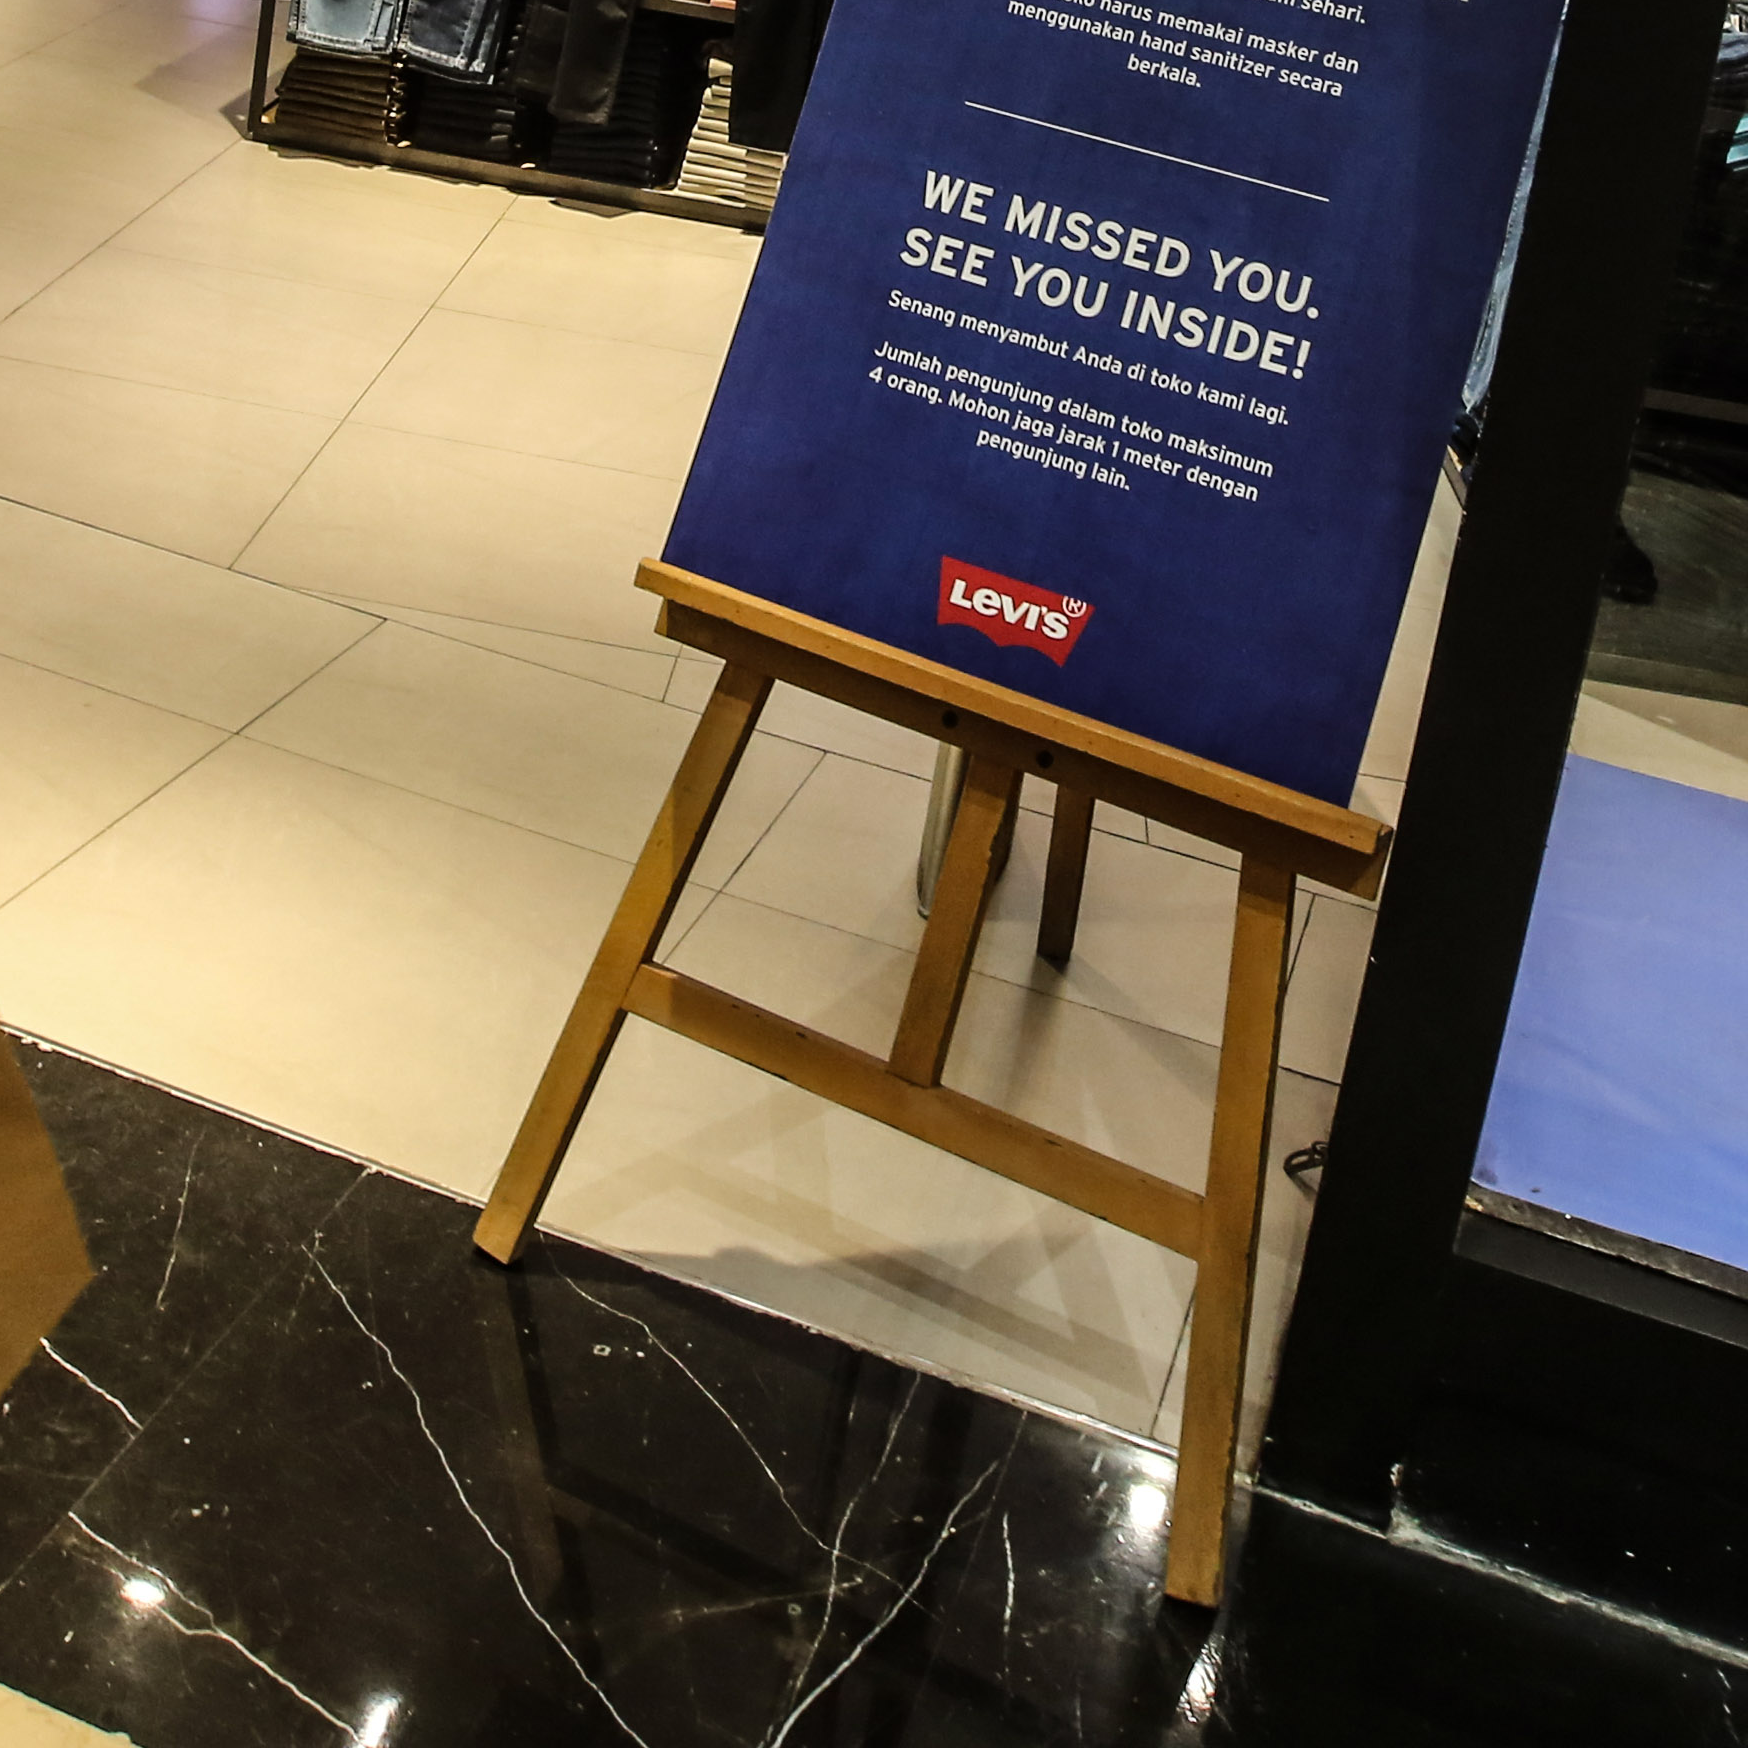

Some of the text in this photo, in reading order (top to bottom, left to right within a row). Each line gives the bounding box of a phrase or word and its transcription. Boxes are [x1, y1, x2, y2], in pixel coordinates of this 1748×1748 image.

[1008, 0, 1342, 96] menggunakan hand sanitizer secara
[1128, 54, 1200, 88] berkala.
[1158, 12, 1244, 44] memakai
[1247, 34, 1318, 62] masker
[1324, 52, 1358, 74] dan
[900, 228, 1310, 379] SEE YOU INSIDE!
[924, 170, 1318, 318] WE MISSED YOU.
[874, 341, 1272, 478] Jumlah pengunjung dalam toko maksimum
[888, 290, 1288, 424] Senang menyambut Anda di toko kami lagi.
[869, 366, 1258, 502] 4 orang. Mohon jaga jarak 1 meter dengan
[976, 430, 1130, 490] pengunjung lain.
